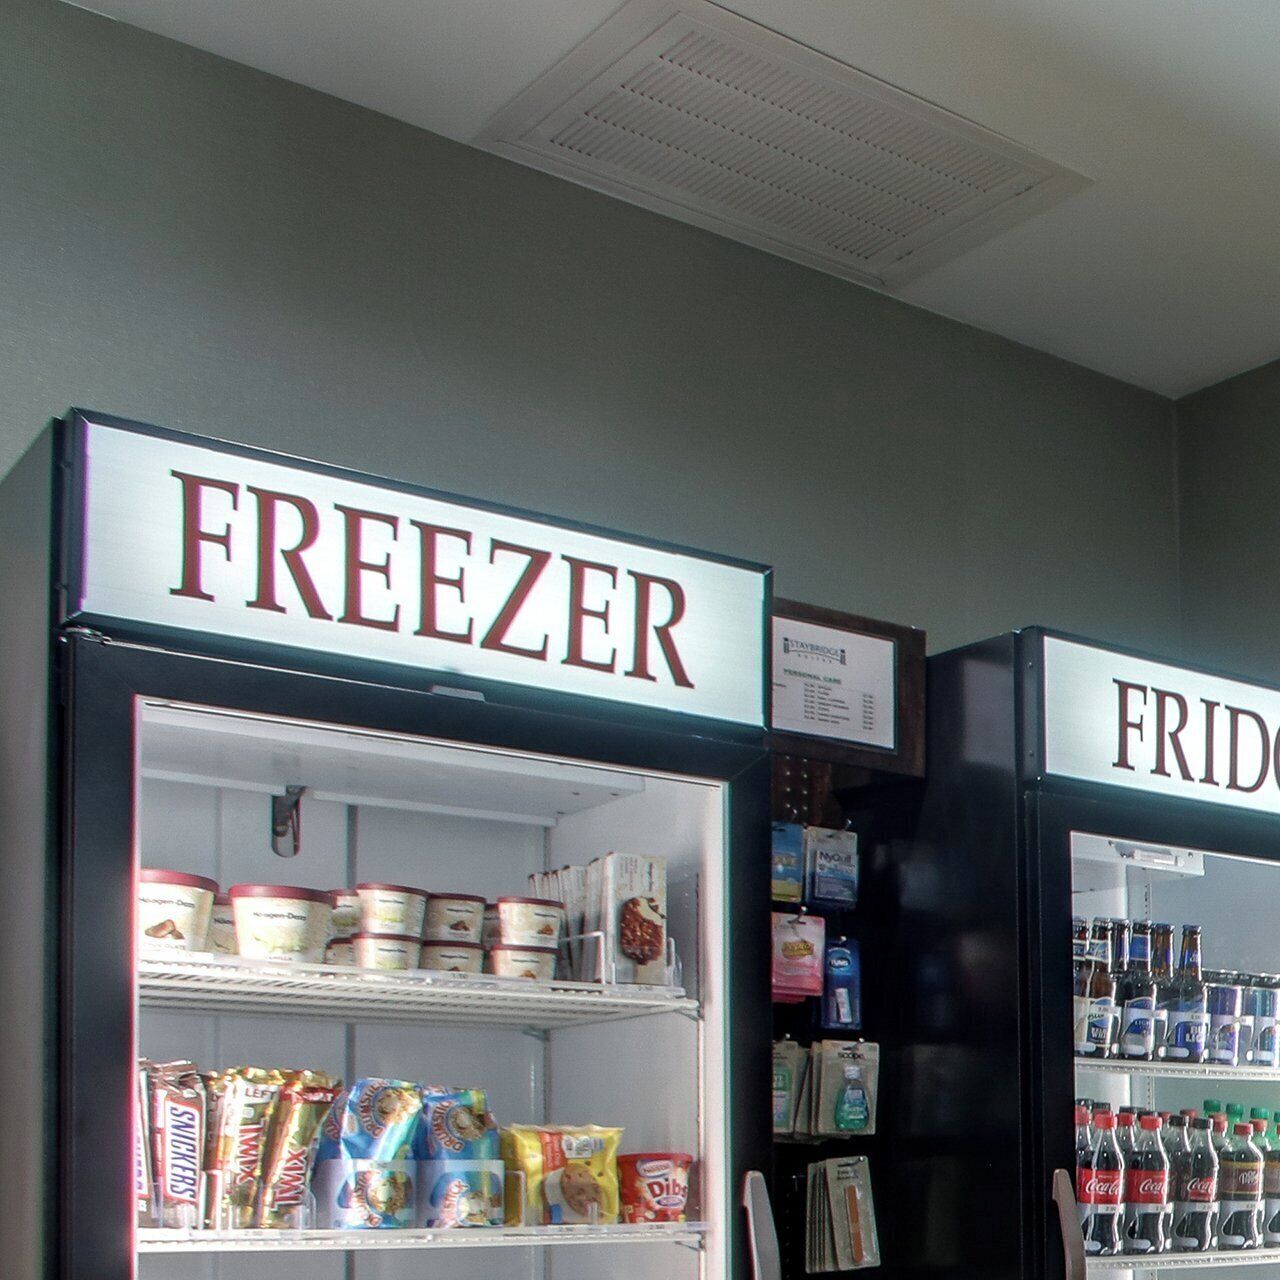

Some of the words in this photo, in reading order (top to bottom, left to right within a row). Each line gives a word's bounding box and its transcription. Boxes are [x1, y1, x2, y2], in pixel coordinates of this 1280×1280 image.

[170, 468, 695, 690] FREEZER
[789, 639, 839, 656] STAYBRIDGE
[170, 1106, 196, 1200] SNICKERS
[236, 1118, 264, 1184] TWIX
[271, 1147, 307, 1213] TWIX
[648, 1176, 688, 1199] Dibs
